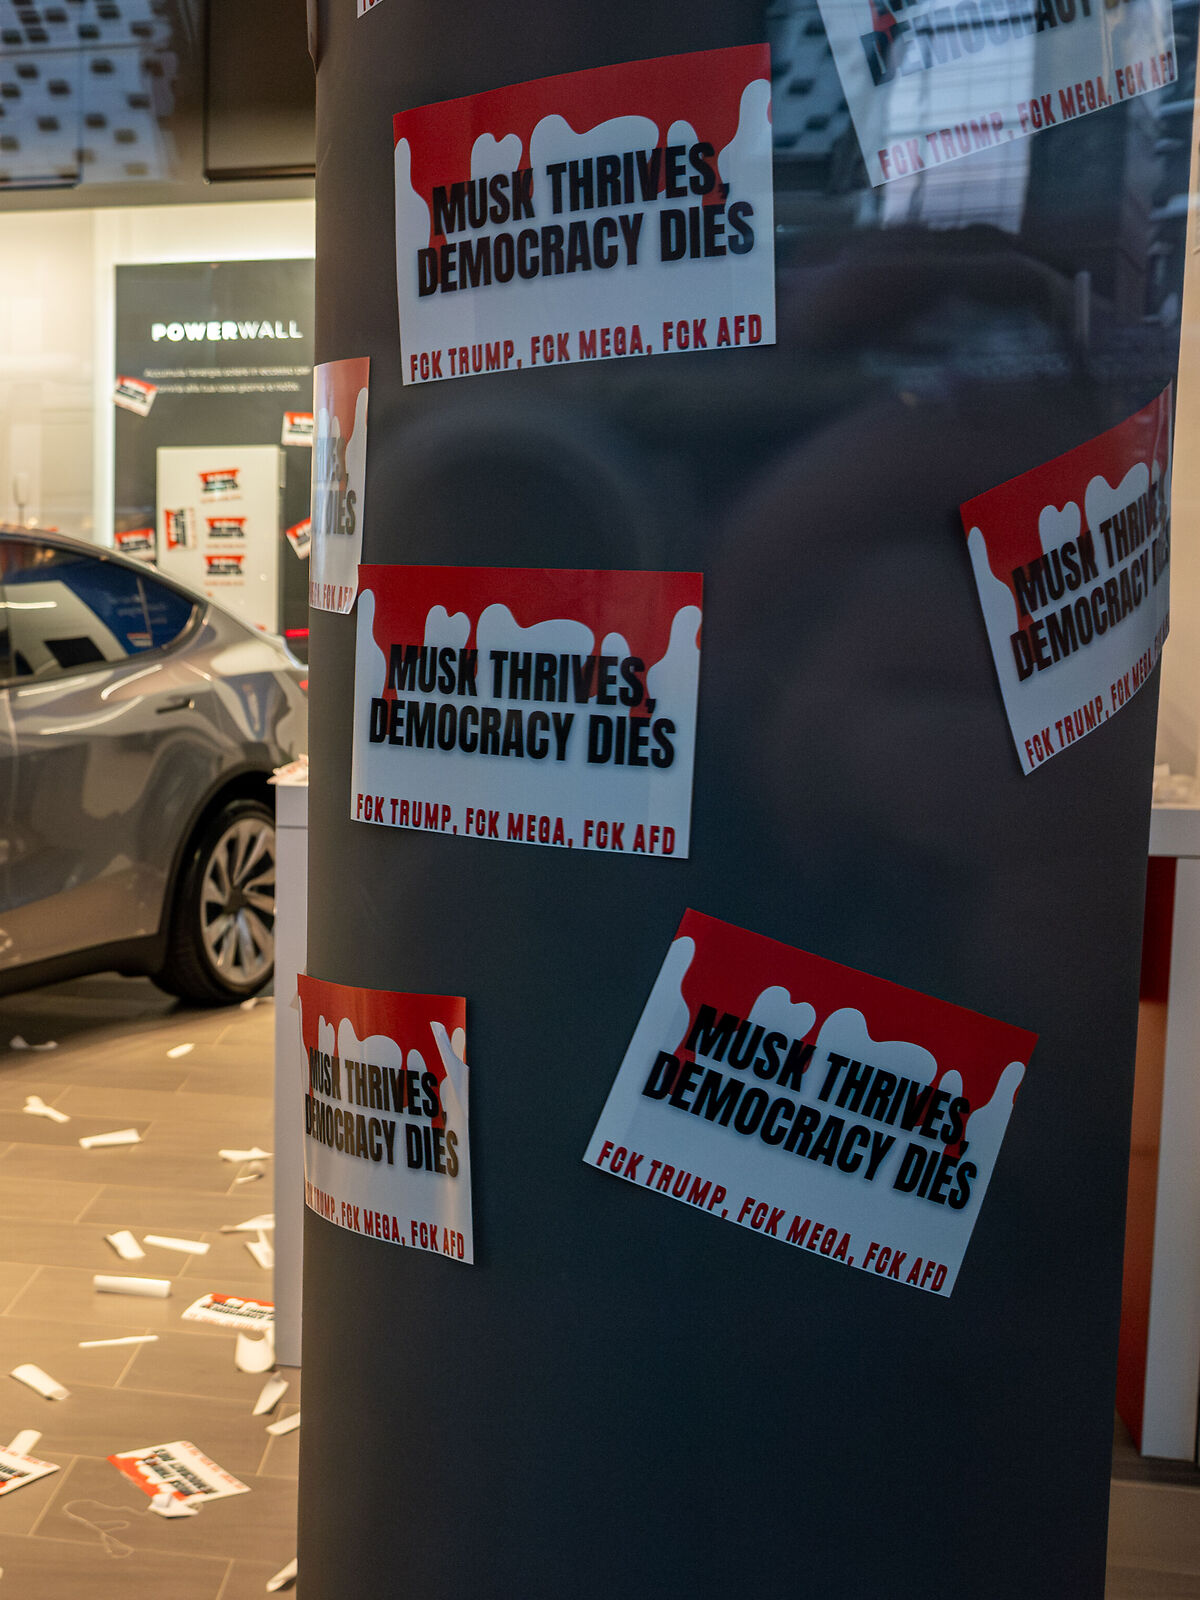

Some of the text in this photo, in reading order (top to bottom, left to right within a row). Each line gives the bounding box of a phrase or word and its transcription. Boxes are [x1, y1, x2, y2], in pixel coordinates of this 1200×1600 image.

[878, 139, 925, 180] FCK
[1018, 97, 1057, 133] FCK
[1115, 61, 1148, 98] FCK
[432, 141, 730, 236] MUSK THRIVES,
[417, 201, 754, 297] DEMOCRACY DIES
[151, 320, 303, 341] POWERWALL
[410, 314, 763, 382] FCK TRUMP, FCK MEGA, FCK AFD
[1010, 548, 1150, 682] DEMOCRACY
[1011, 530, 1098, 616] MUSK
[388, 644, 656, 714] MUSK THRIVES,
[1025, 726, 1054, 768] FCK
[1055, 695, 1110, 748] TRUMP,
[1110, 676, 1131, 710] FCK
[369, 698, 676, 768] DEMOCRACY DIES
[356, 794, 675, 855] FCK TRUMP, FCK MEGA, FCK AFD
[309, 1047, 447, 1123] MUSK THRIVES,
[684, 1004, 972, 1156] MUSK THRIVES,
[305, 1094, 459, 1178] DEMOCRACY DIES
[642, 1050, 978, 1210] DEMOCRACY DIES
[341, 1201, 361, 1232] FCK
[363, 1208, 405, 1247] MEGA,
[411, 1220, 439, 1252] FCK
[443, 1227, 465, 1259] AFD
[596, 1141, 949, 1291] FCK TRUMP, FCK MEGA, FCK AFD
